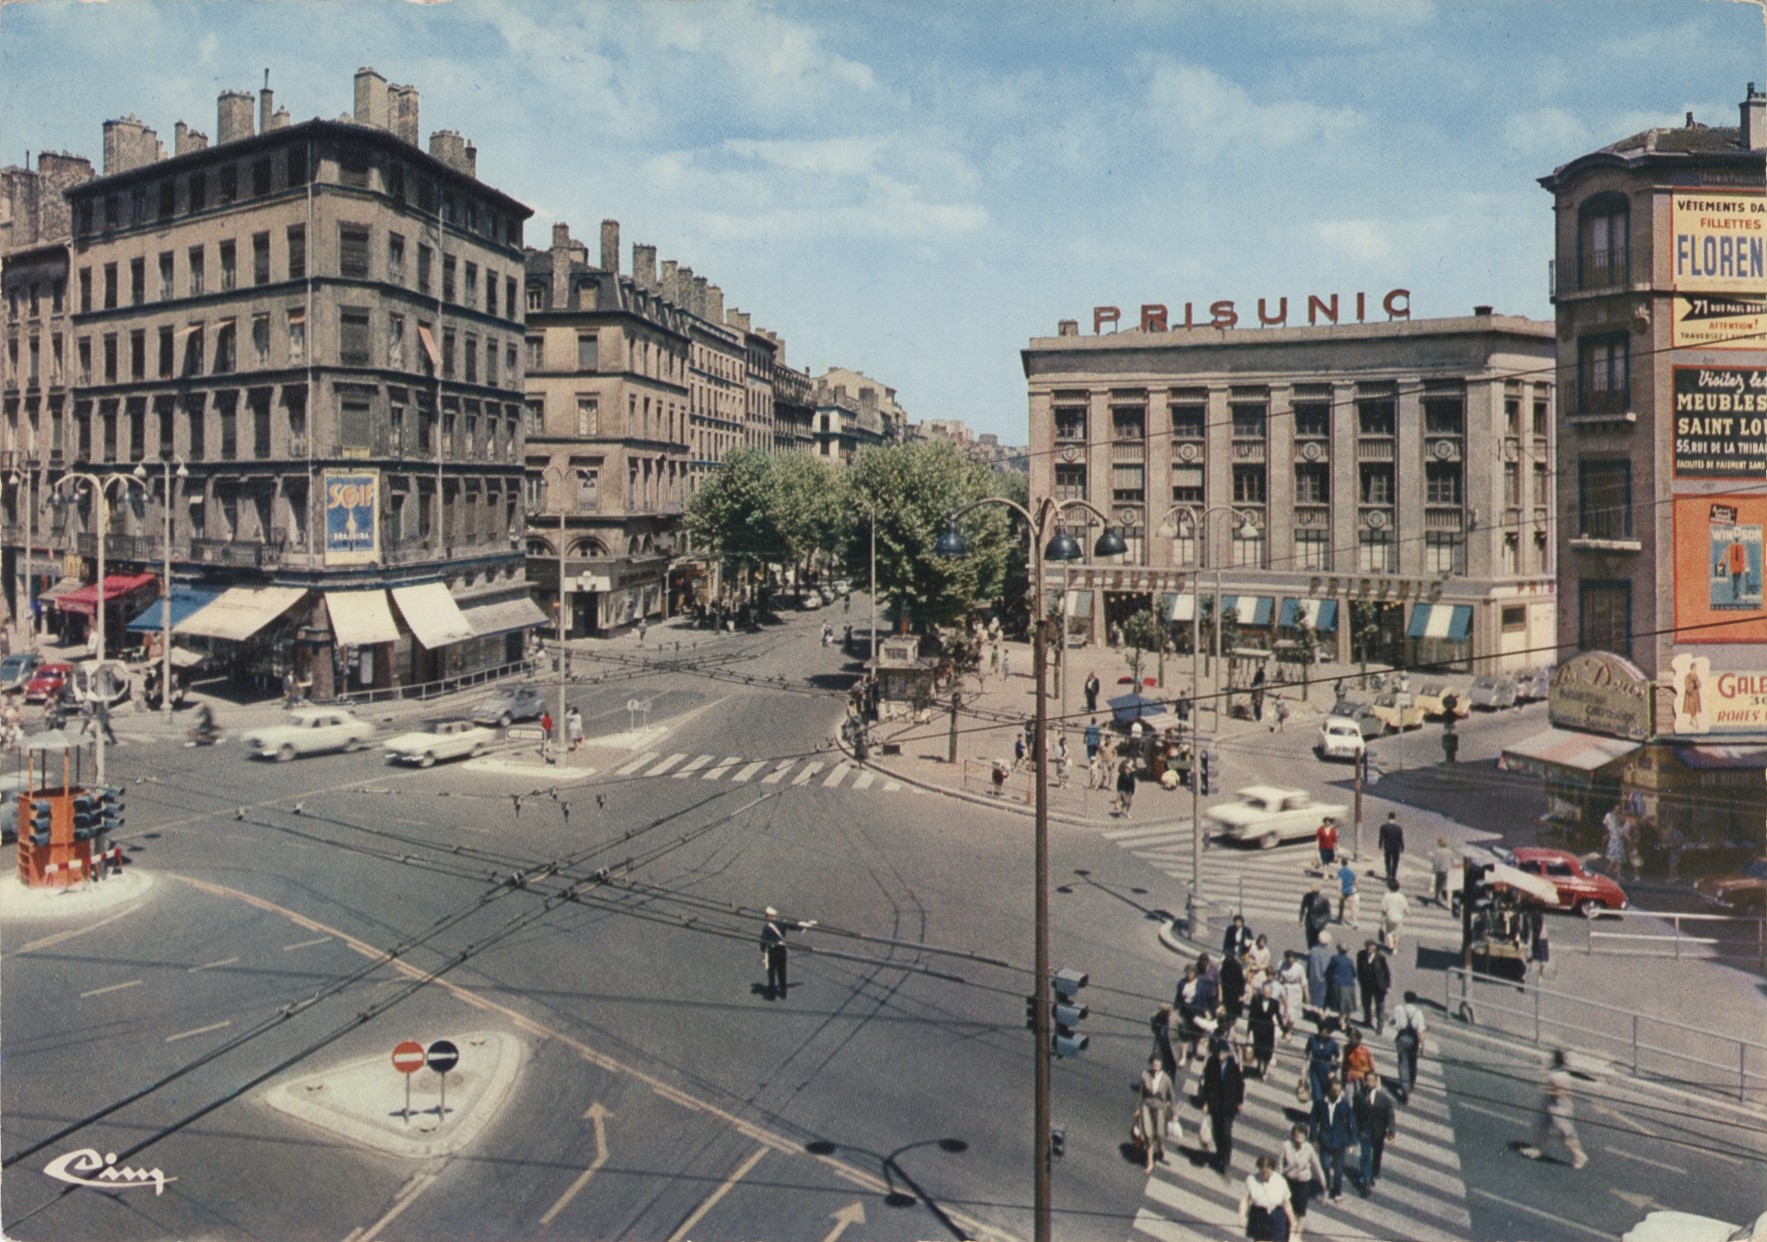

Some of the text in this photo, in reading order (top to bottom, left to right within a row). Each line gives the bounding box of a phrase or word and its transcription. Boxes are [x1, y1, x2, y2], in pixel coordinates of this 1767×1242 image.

[1678, 200, 1745, 212] VÊTEMENTS
[1700, 218, 1761, 229] FILLETTES
[1094, 288, 1410, 334] PRISUNIC
[1693, 300, 1708, 315] 71
[1727, 304, 1744, 313] PAUL
[1699, 370, 1745, 394] Visitez
[1677, 393, 1767, 411] MEUBLES
[1678, 417, 1733, 436] SAINT
[1710, 441, 1721, 454] DE
[1724, 441, 1735, 454] LA
[328, 483, 374, 510] SOIF
[1067, 568, 1186, 592] PRISUNIC
[1309, 576, 1442, 604] PRISUNIC
